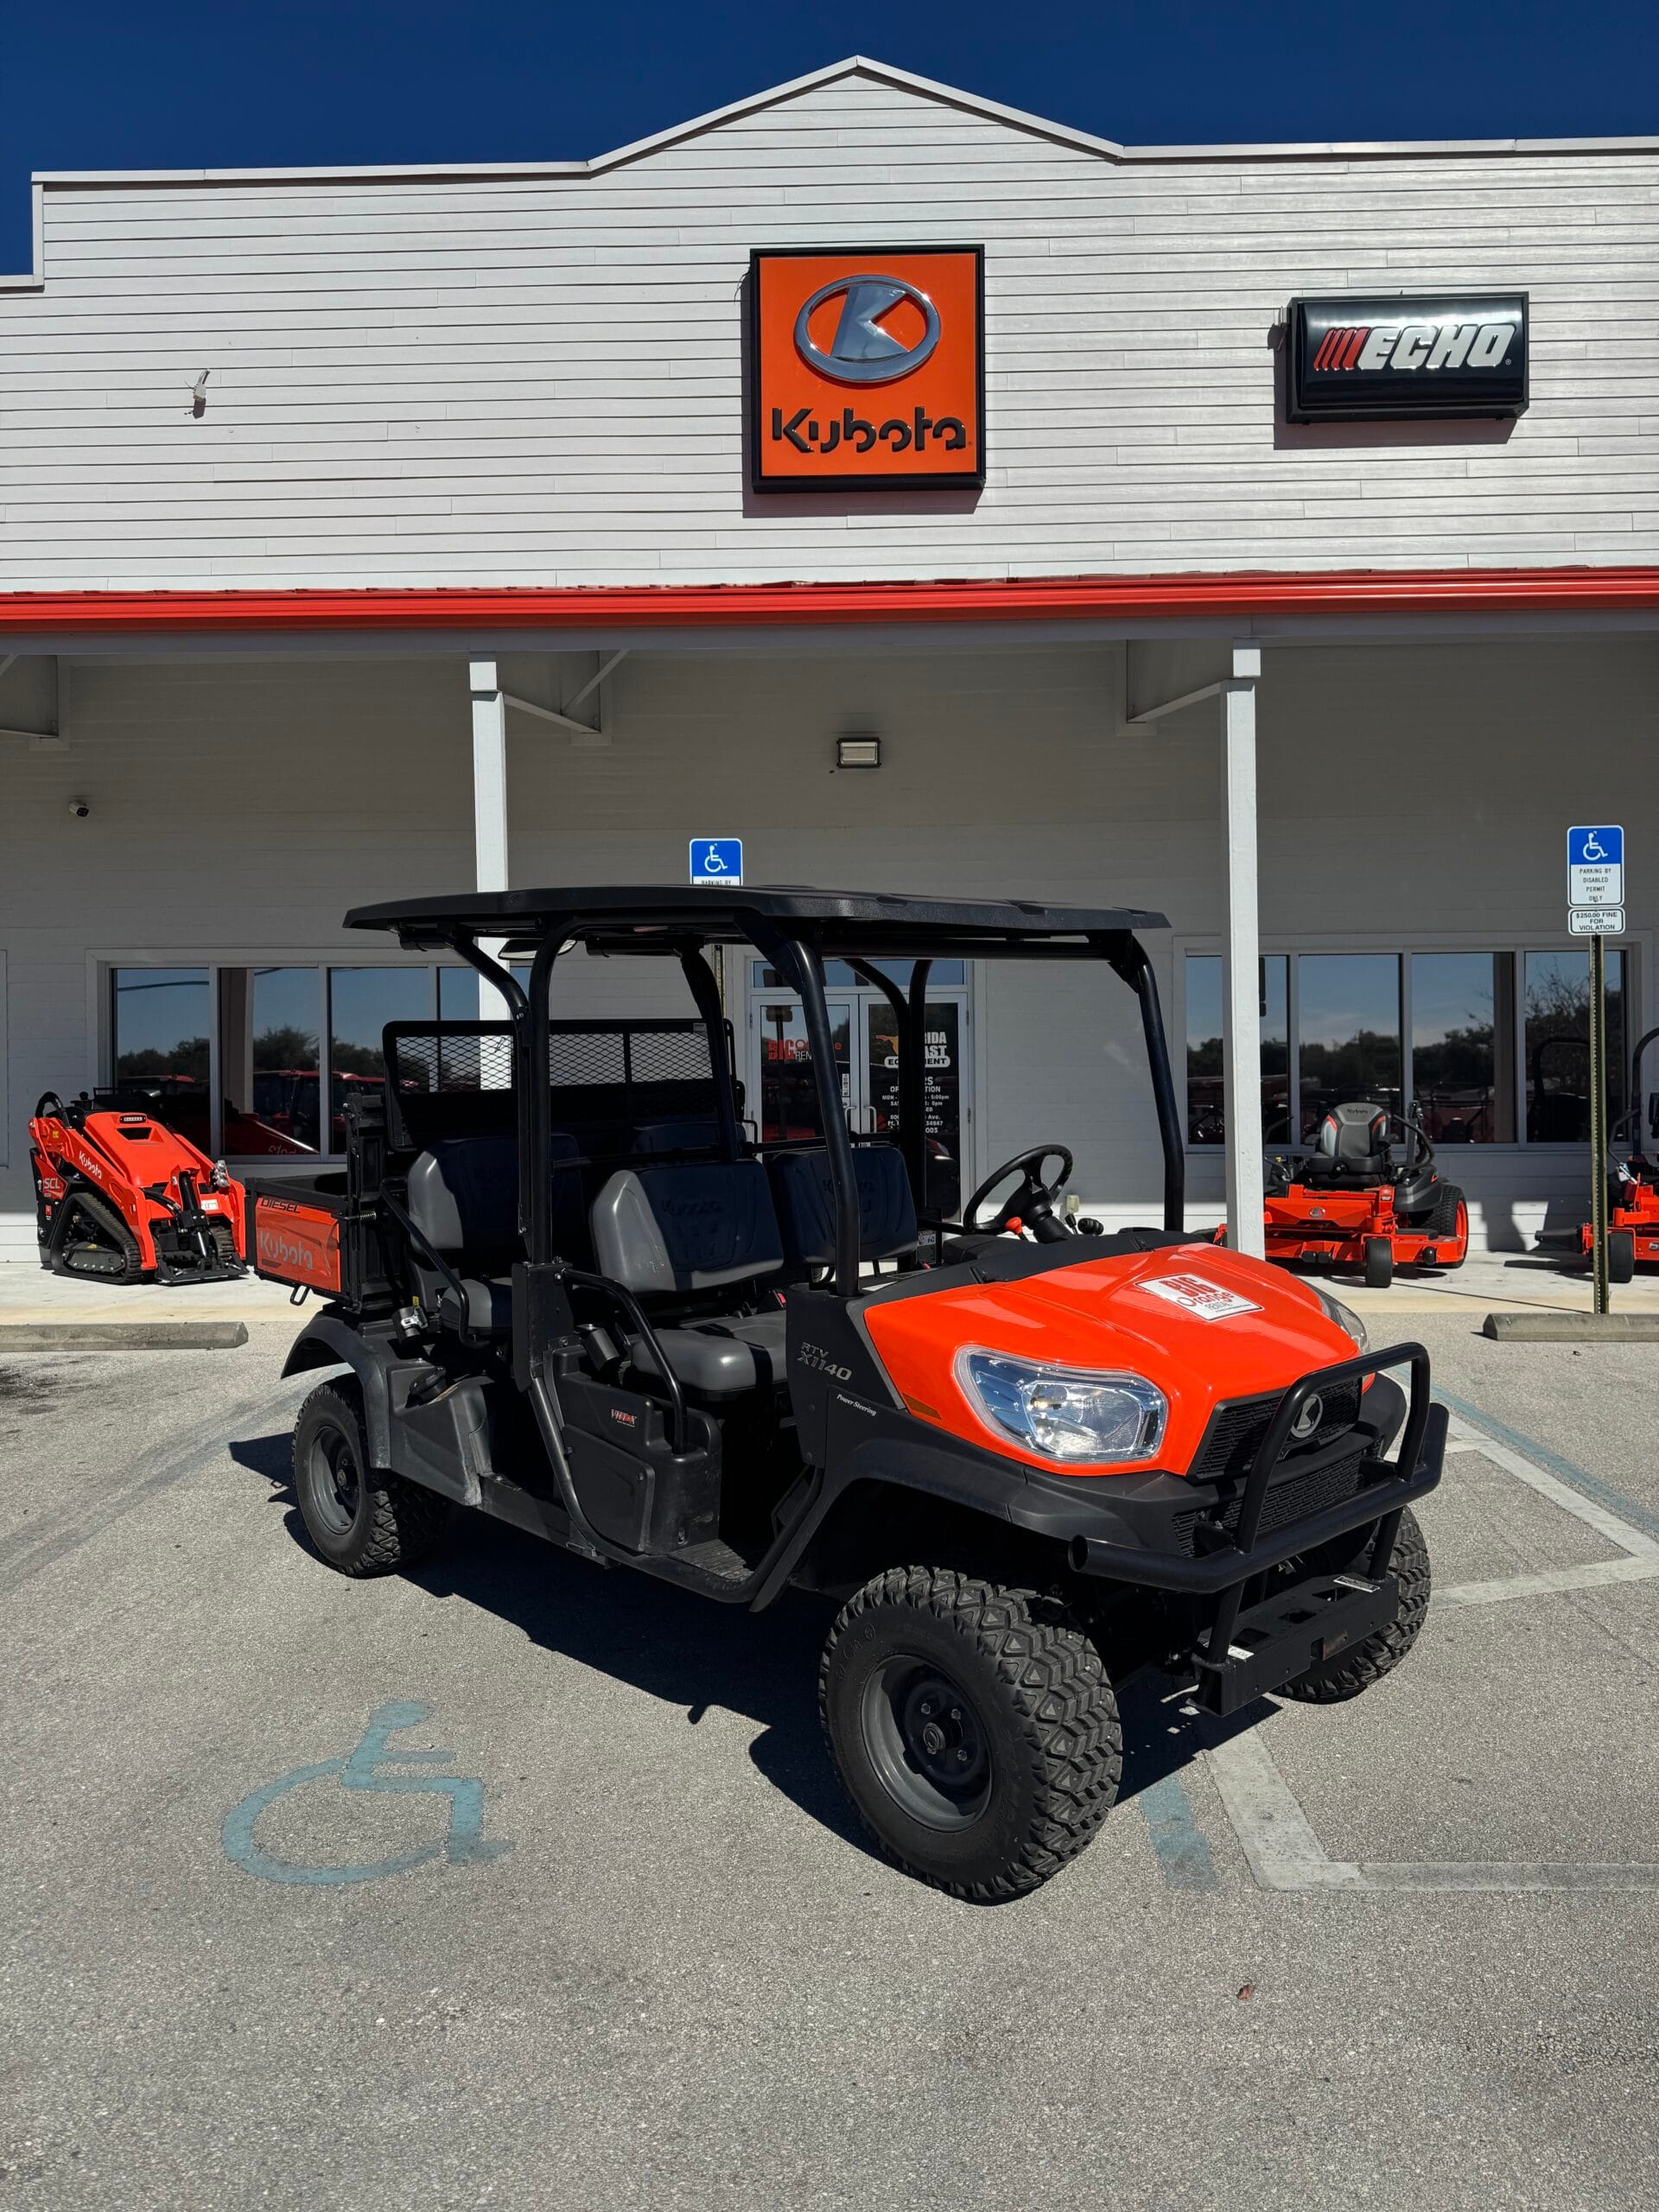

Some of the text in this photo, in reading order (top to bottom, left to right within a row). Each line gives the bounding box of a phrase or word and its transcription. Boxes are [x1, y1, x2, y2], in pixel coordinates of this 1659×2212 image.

[1357, 323, 1516, 370] ECHO
[772, 407, 965, 453] Kubota
[767, 1039, 794, 1060] BIG
[79, 1150, 102, 1179] Kubota
[43, 1178, 60, 1189] SCL
[261, 1199, 301, 1214] DIESEL
[259, 1230, 314, 1270] Kubota
[1176, 1291, 1235, 1306] Orange
[802, 1342, 829, 1357] RTV
[798, 1351, 852, 1381] X1140
[836, 1394, 877, 1416] Power Steering
